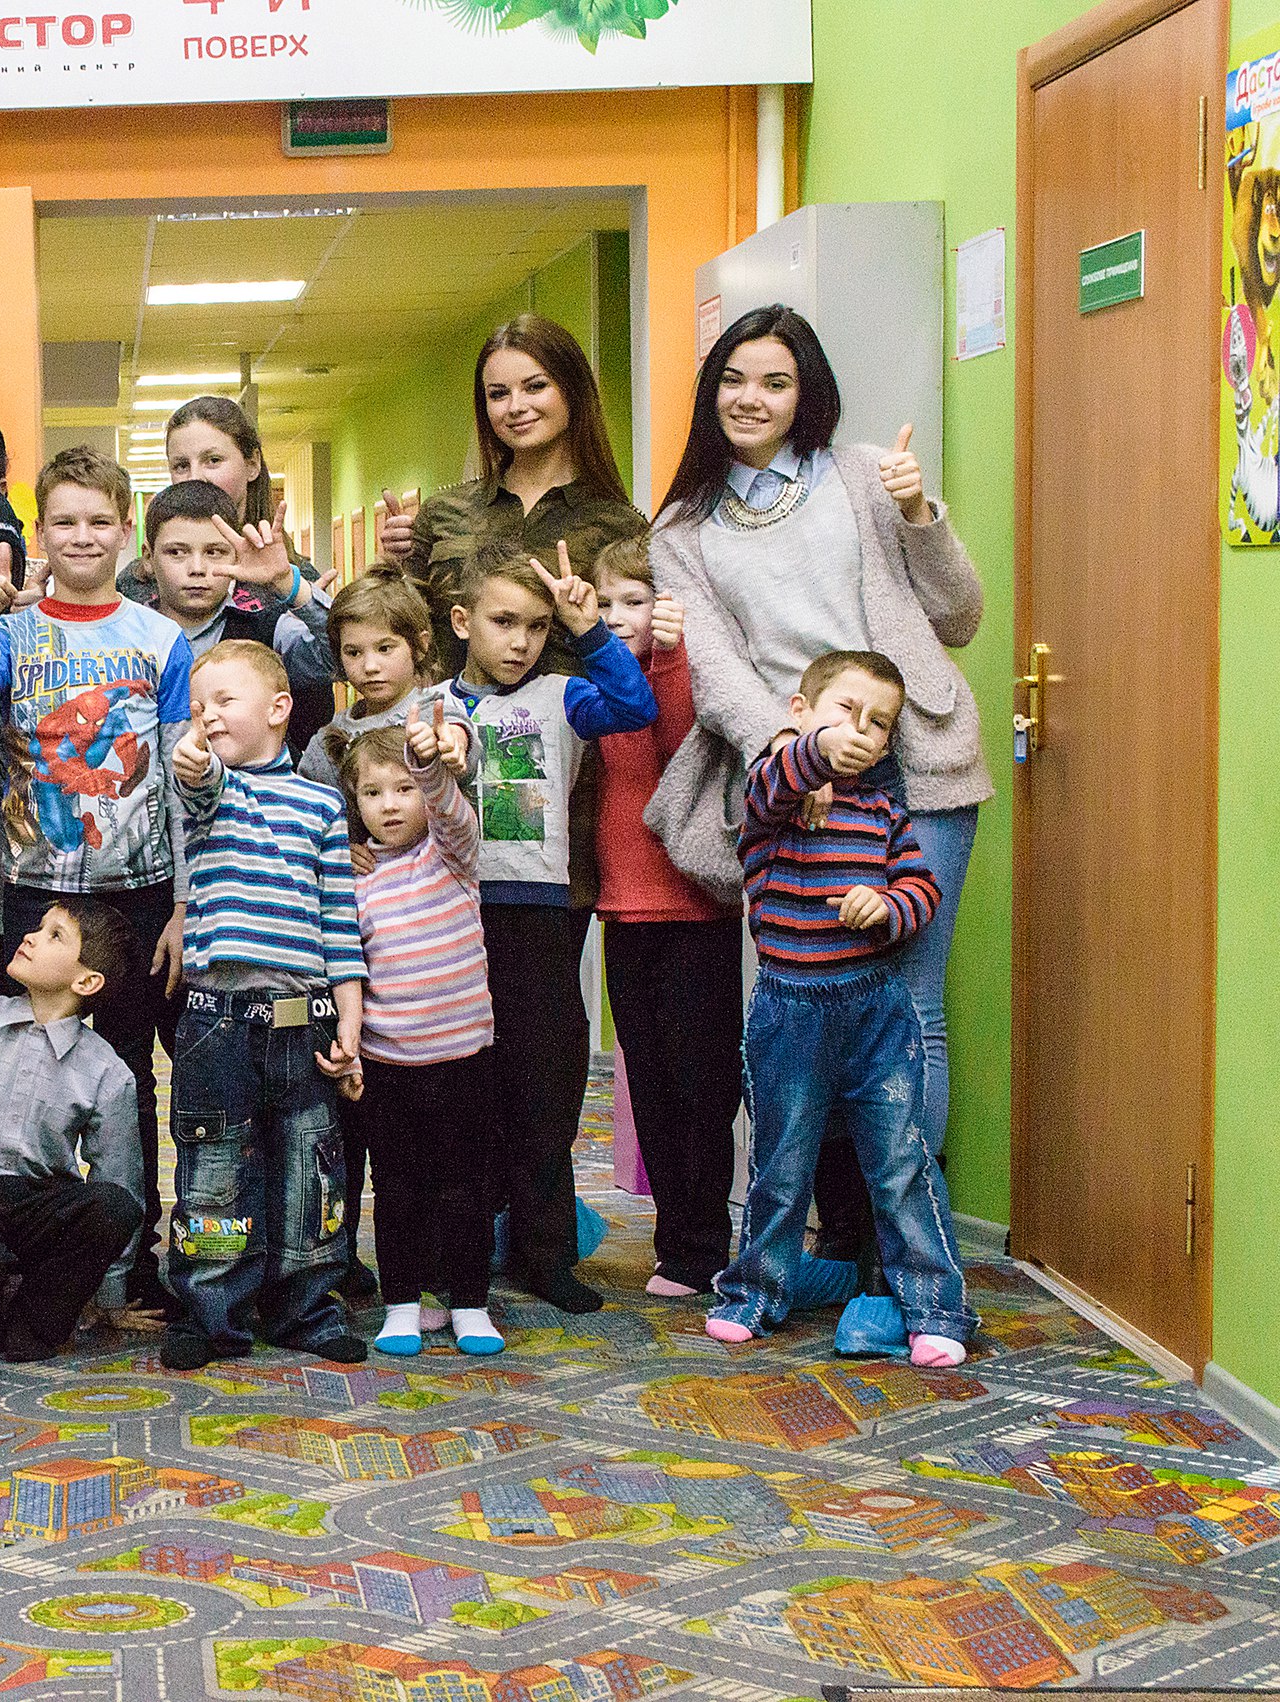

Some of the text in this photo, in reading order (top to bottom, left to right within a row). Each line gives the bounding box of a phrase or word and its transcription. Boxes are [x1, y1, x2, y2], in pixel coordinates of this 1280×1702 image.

[183, 34, 309, 59] ПОВЕРХ
[63, 61, 136, 73] центр
[189, 1216, 253, 1235] HOORAY!
